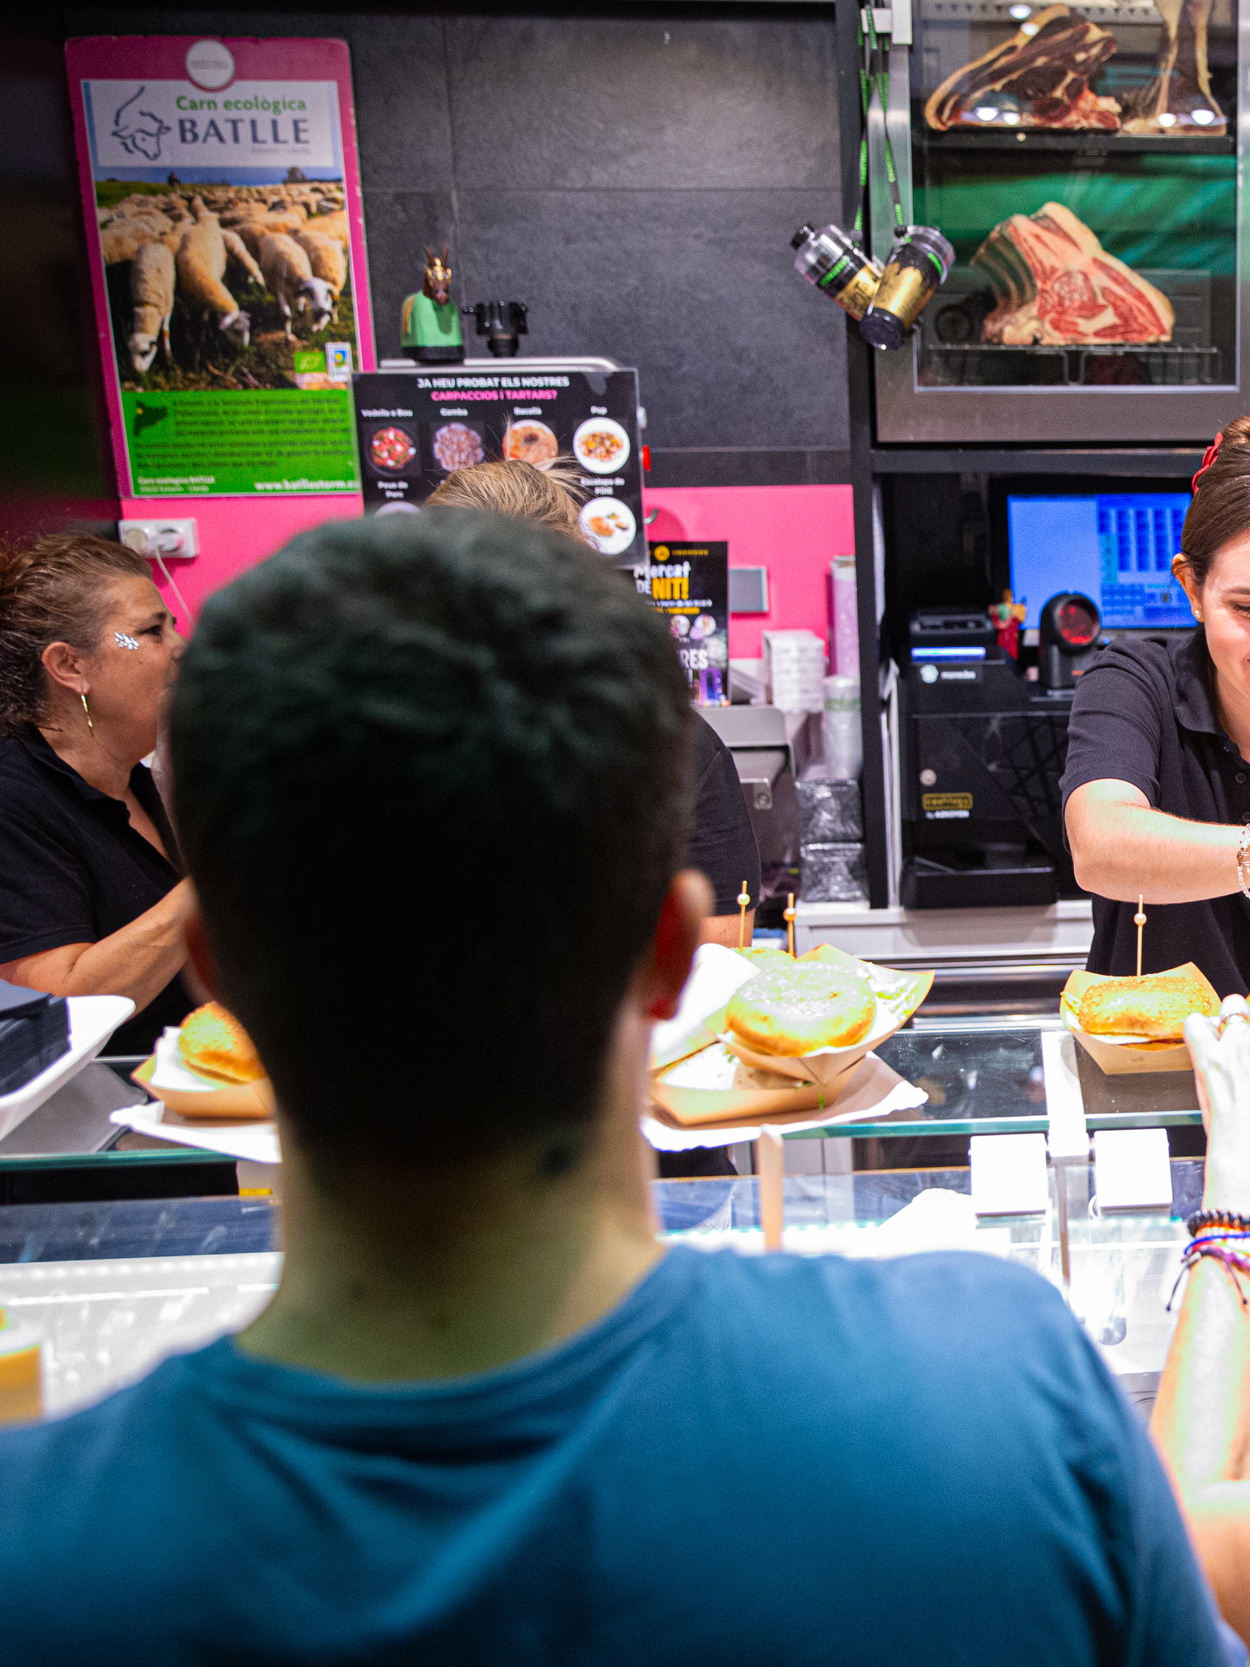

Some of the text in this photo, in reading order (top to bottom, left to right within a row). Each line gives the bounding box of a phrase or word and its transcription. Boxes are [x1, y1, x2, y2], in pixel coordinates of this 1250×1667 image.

[176, 95, 306, 115] Carn ecològica
[178, 118, 310, 144] BATLLE
[456, 377, 500, 388] PROBAT
[500, 377, 521, 388] ELS
[521, 376, 570, 388] NOSTRES
